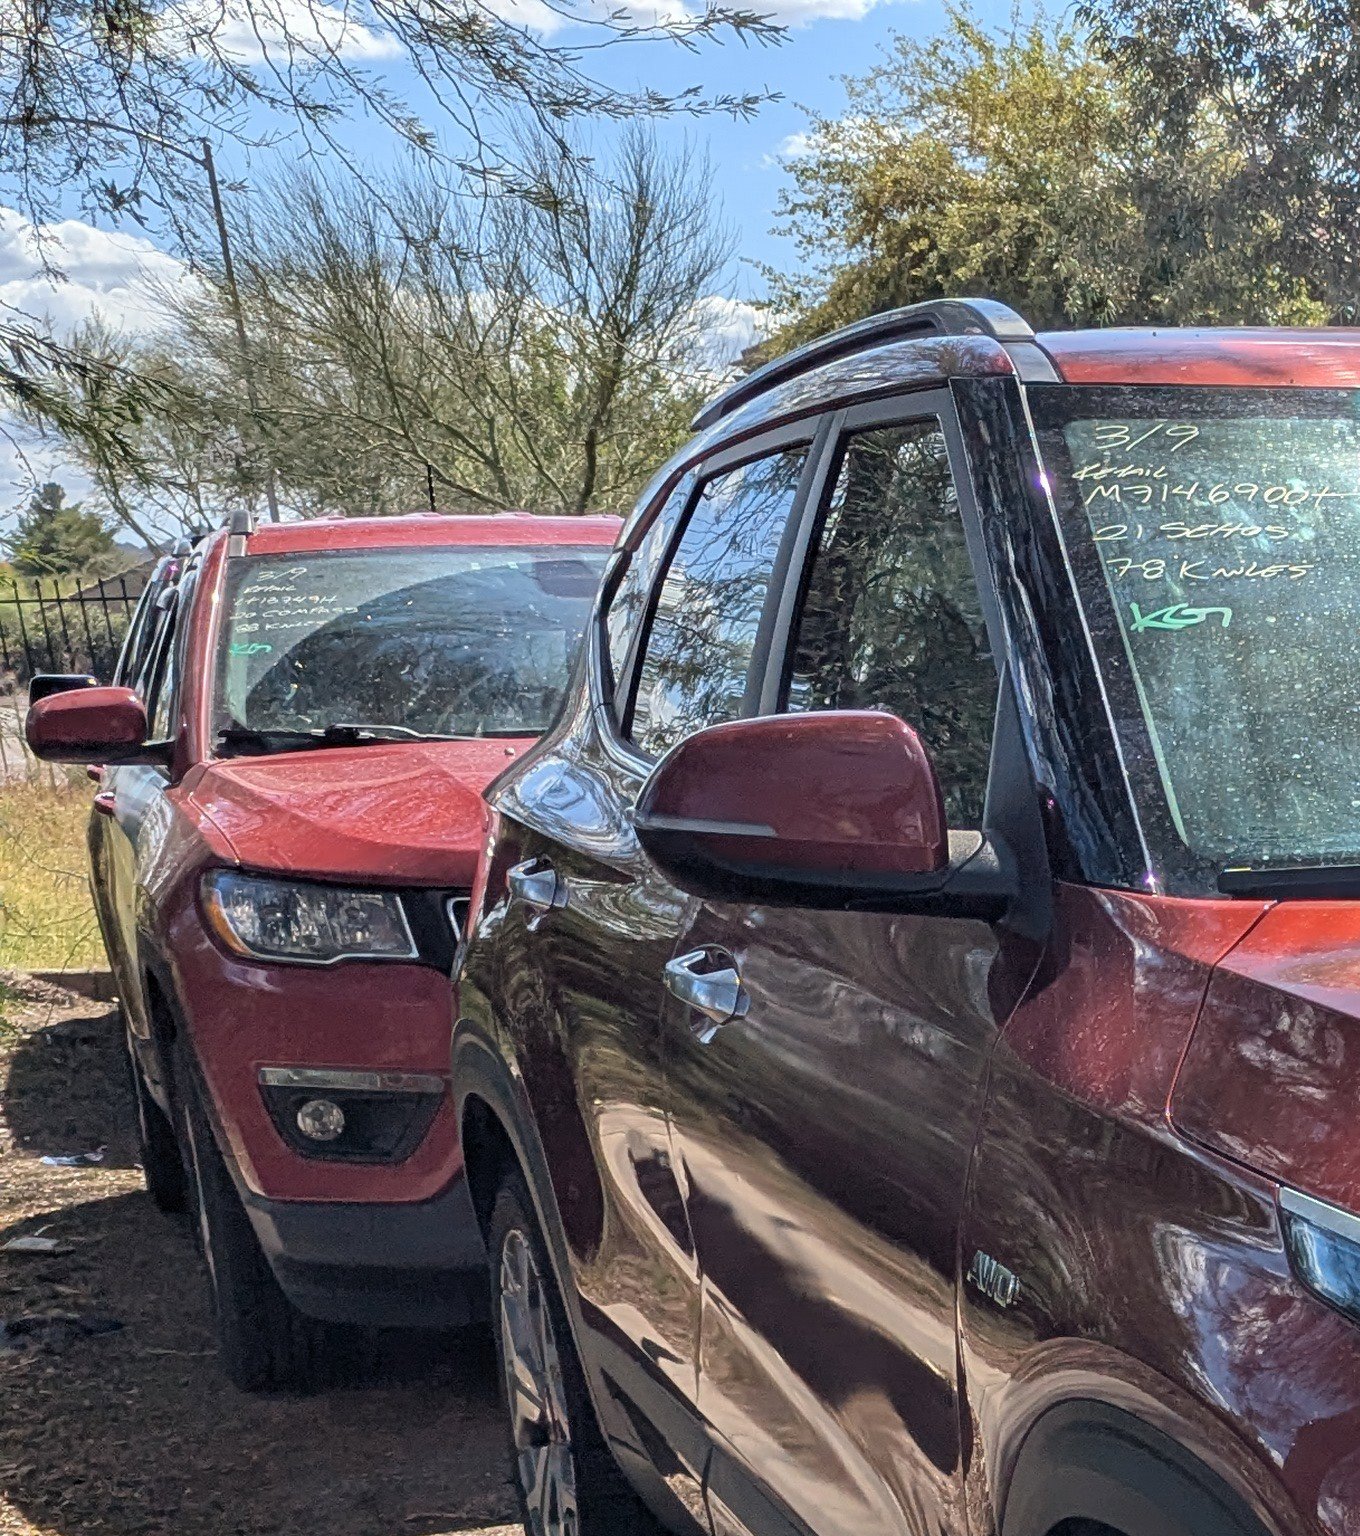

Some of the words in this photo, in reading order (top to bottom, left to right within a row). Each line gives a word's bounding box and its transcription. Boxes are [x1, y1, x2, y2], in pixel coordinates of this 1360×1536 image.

[1095, 423, 1200, 452] 3/9
[1092, 524, 1143, 542] 21
[256, 566, 308, 582] 3/9
[1105, 557, 1166, 580] 78
